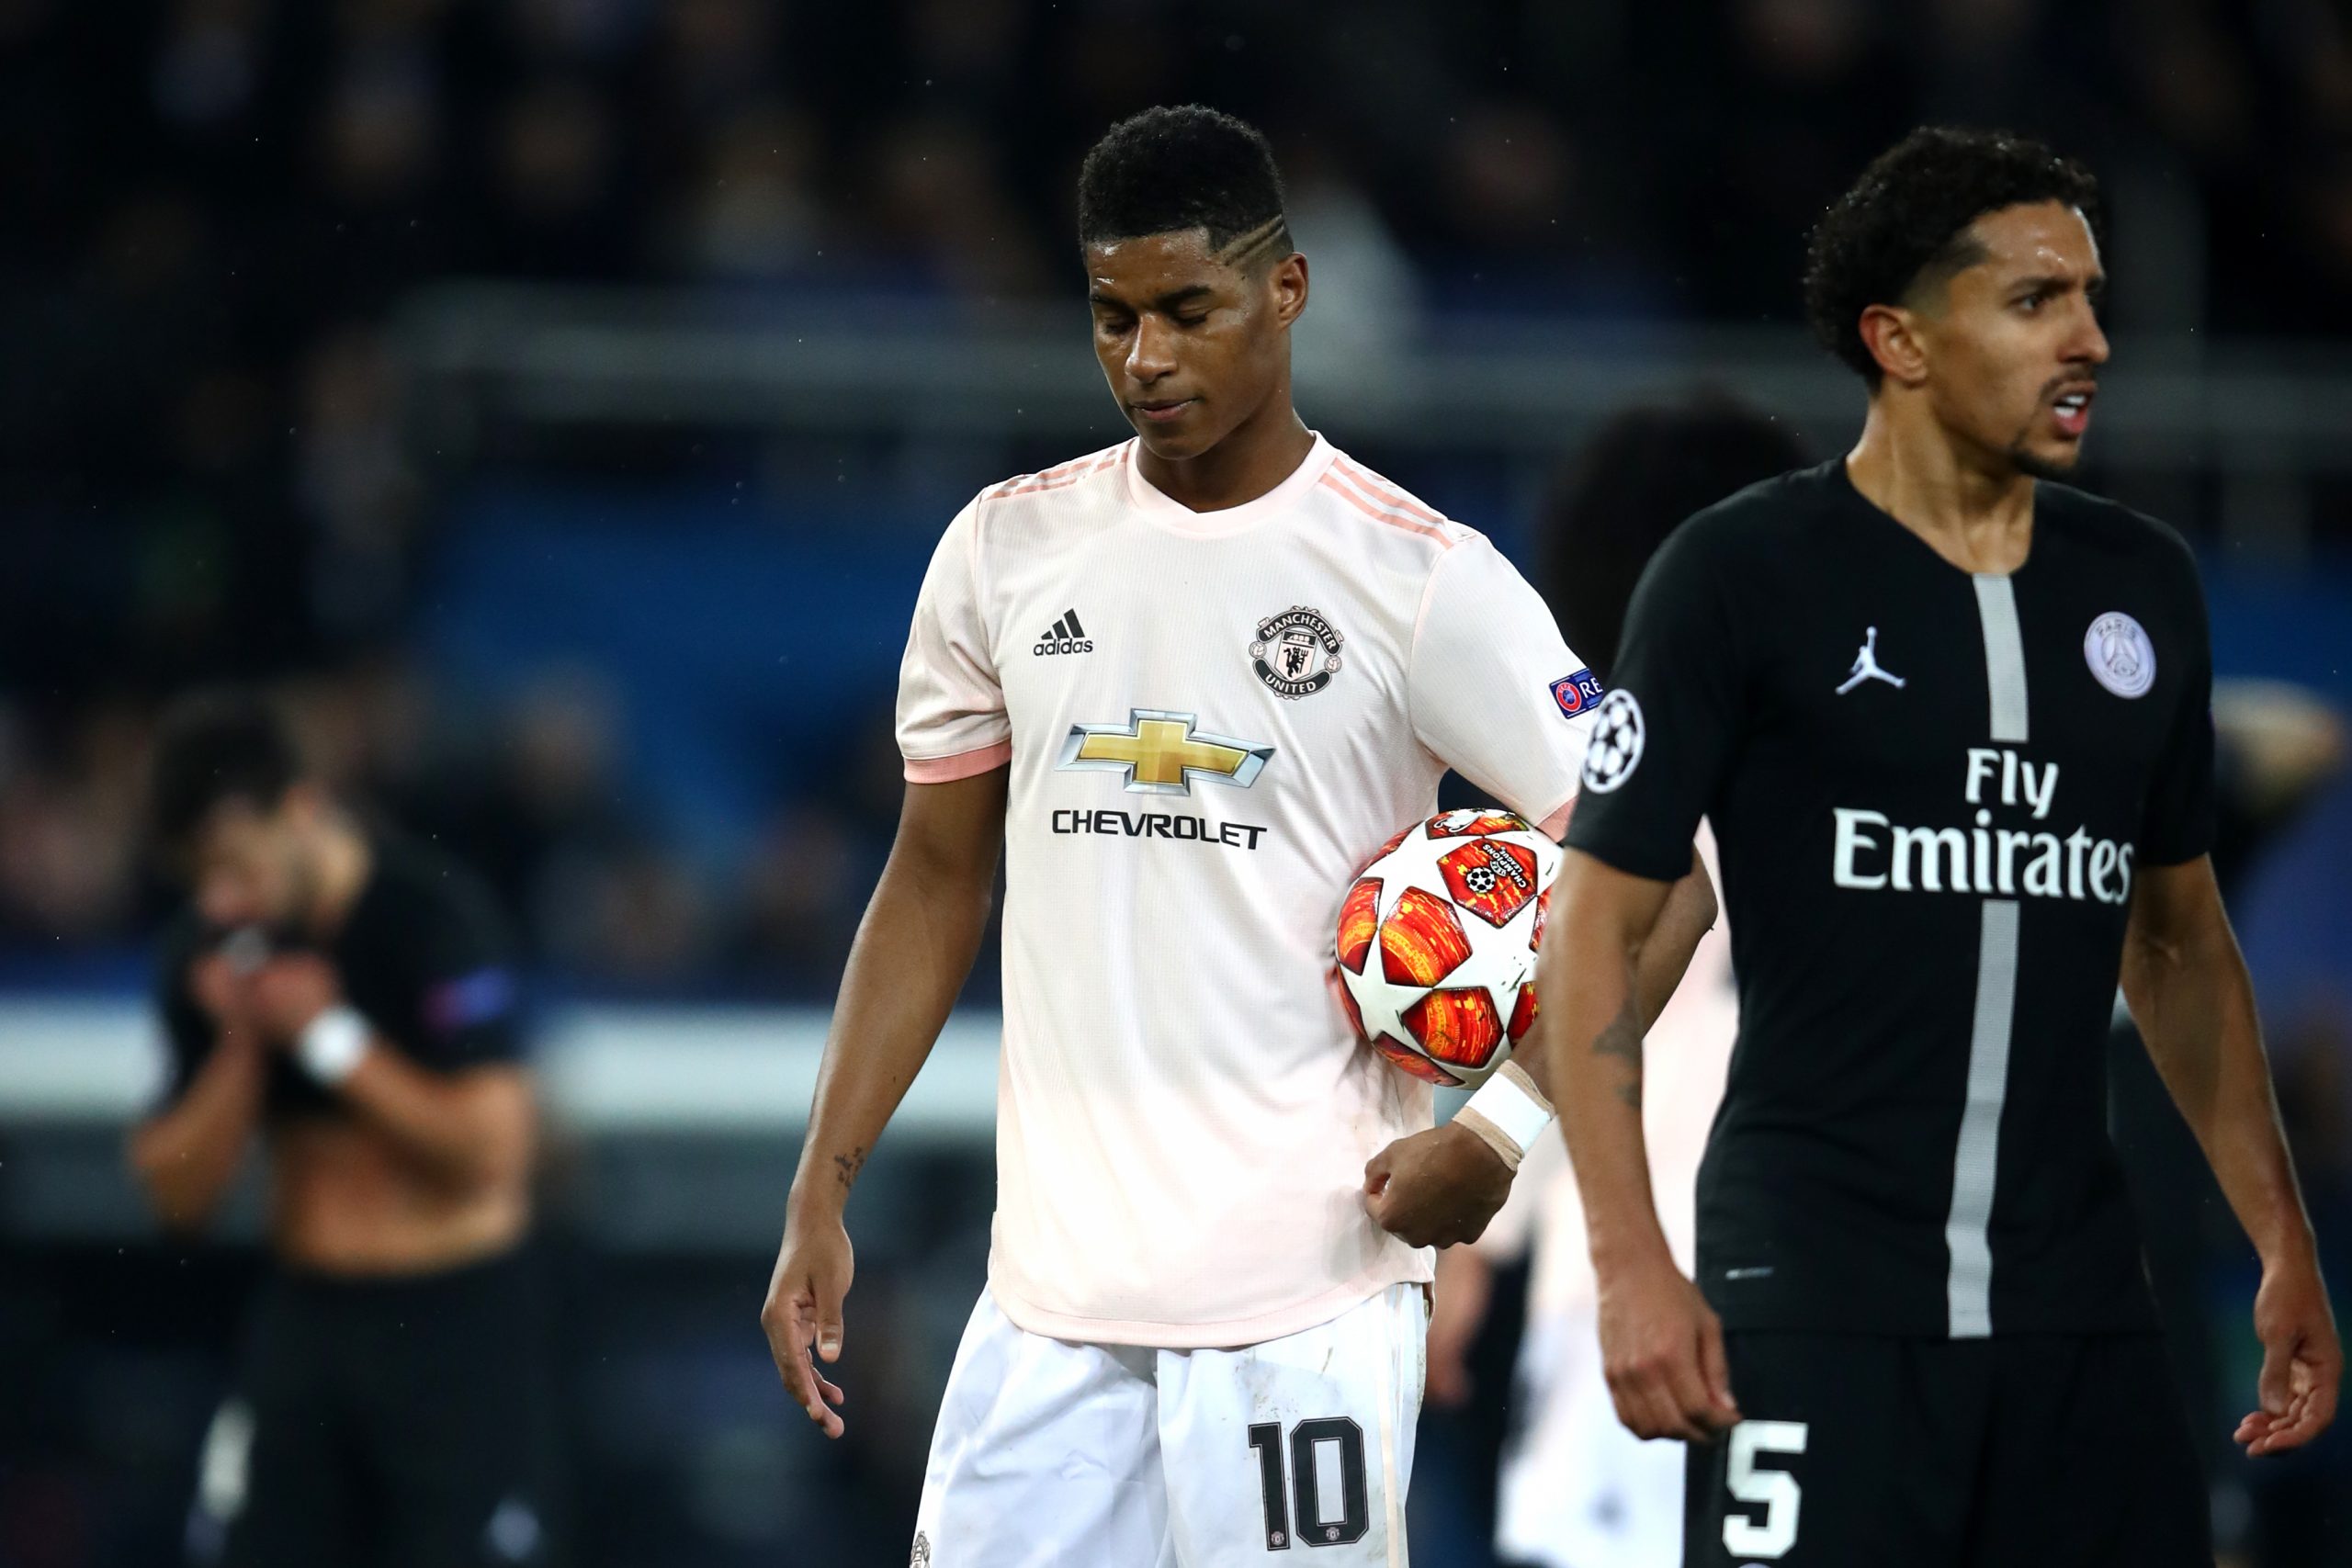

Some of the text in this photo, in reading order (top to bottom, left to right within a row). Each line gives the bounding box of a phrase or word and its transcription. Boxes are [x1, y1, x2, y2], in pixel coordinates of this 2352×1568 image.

[1033, 637, 1093, 657] adidas
[1263, 614, 1337, 649] MANCHESTER
[2096, 617, 2137, 641] PARIS
[1265, 673, 1317, 694] UNITED
[1965, 748, 2059, 819] Fly
[1052, 810, 1267, 851] CHEVROLET
[1482, 843, 1527, 888] CHAMPIONS
[1499, 850, 1523, 873] LEAGUE
[1833, 807, 2134, 905] Emirates
[1248, 1416, 1370, 1551] 10
[1722, 1419, 1809, 1560] 5
